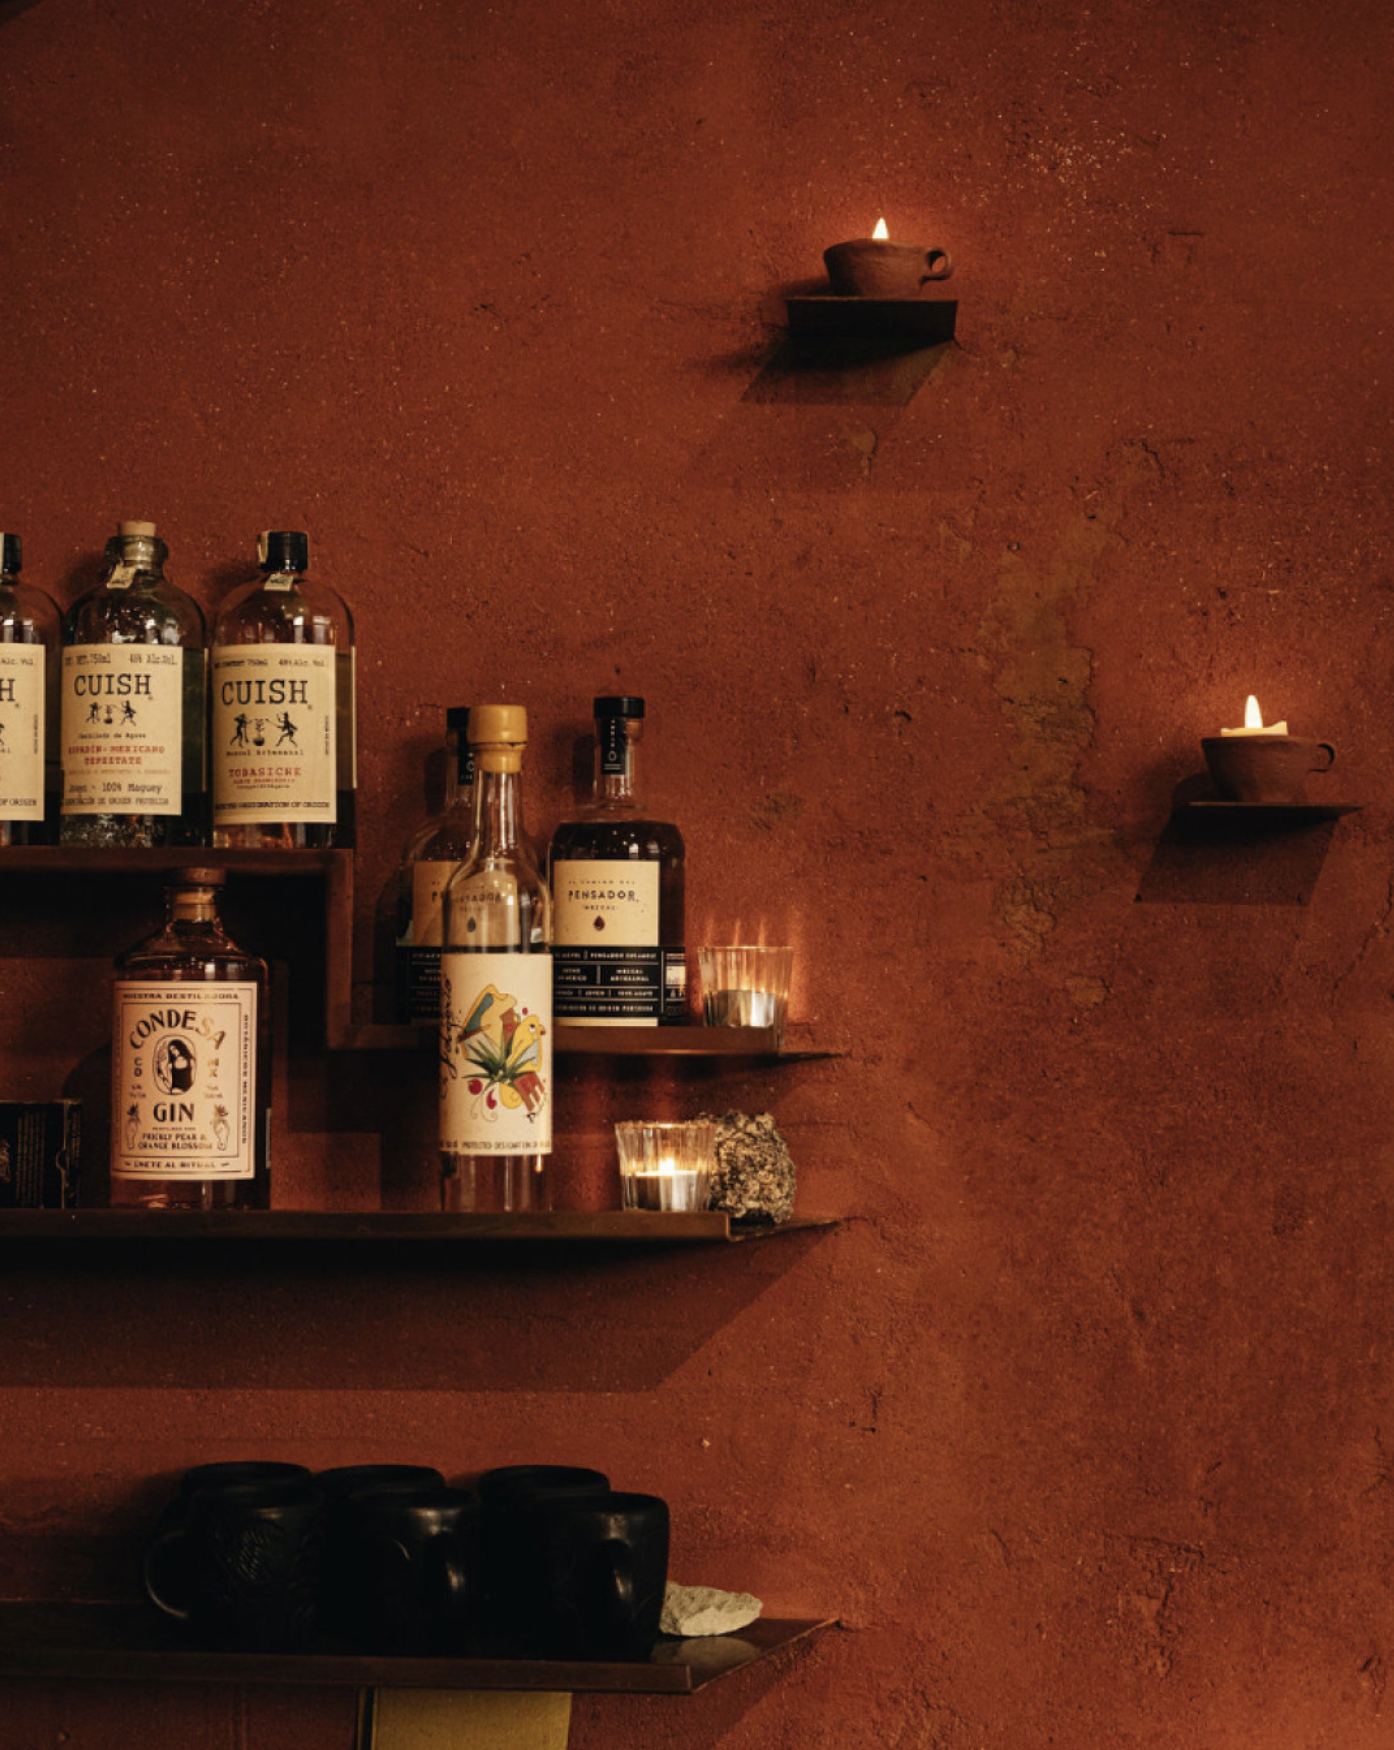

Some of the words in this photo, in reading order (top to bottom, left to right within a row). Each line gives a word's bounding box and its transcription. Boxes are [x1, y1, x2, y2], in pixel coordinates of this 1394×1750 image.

[73, 673, 152, 697] CUISH
[221, 679, 308, 706] CUISH
[568, 889, 636, 902] PENSADOR
[130, 1008, 227, 1050] CONDESA
[153, 1102, 195, 1123] GIN
[175, 1132, 197, 1141] PEAR
